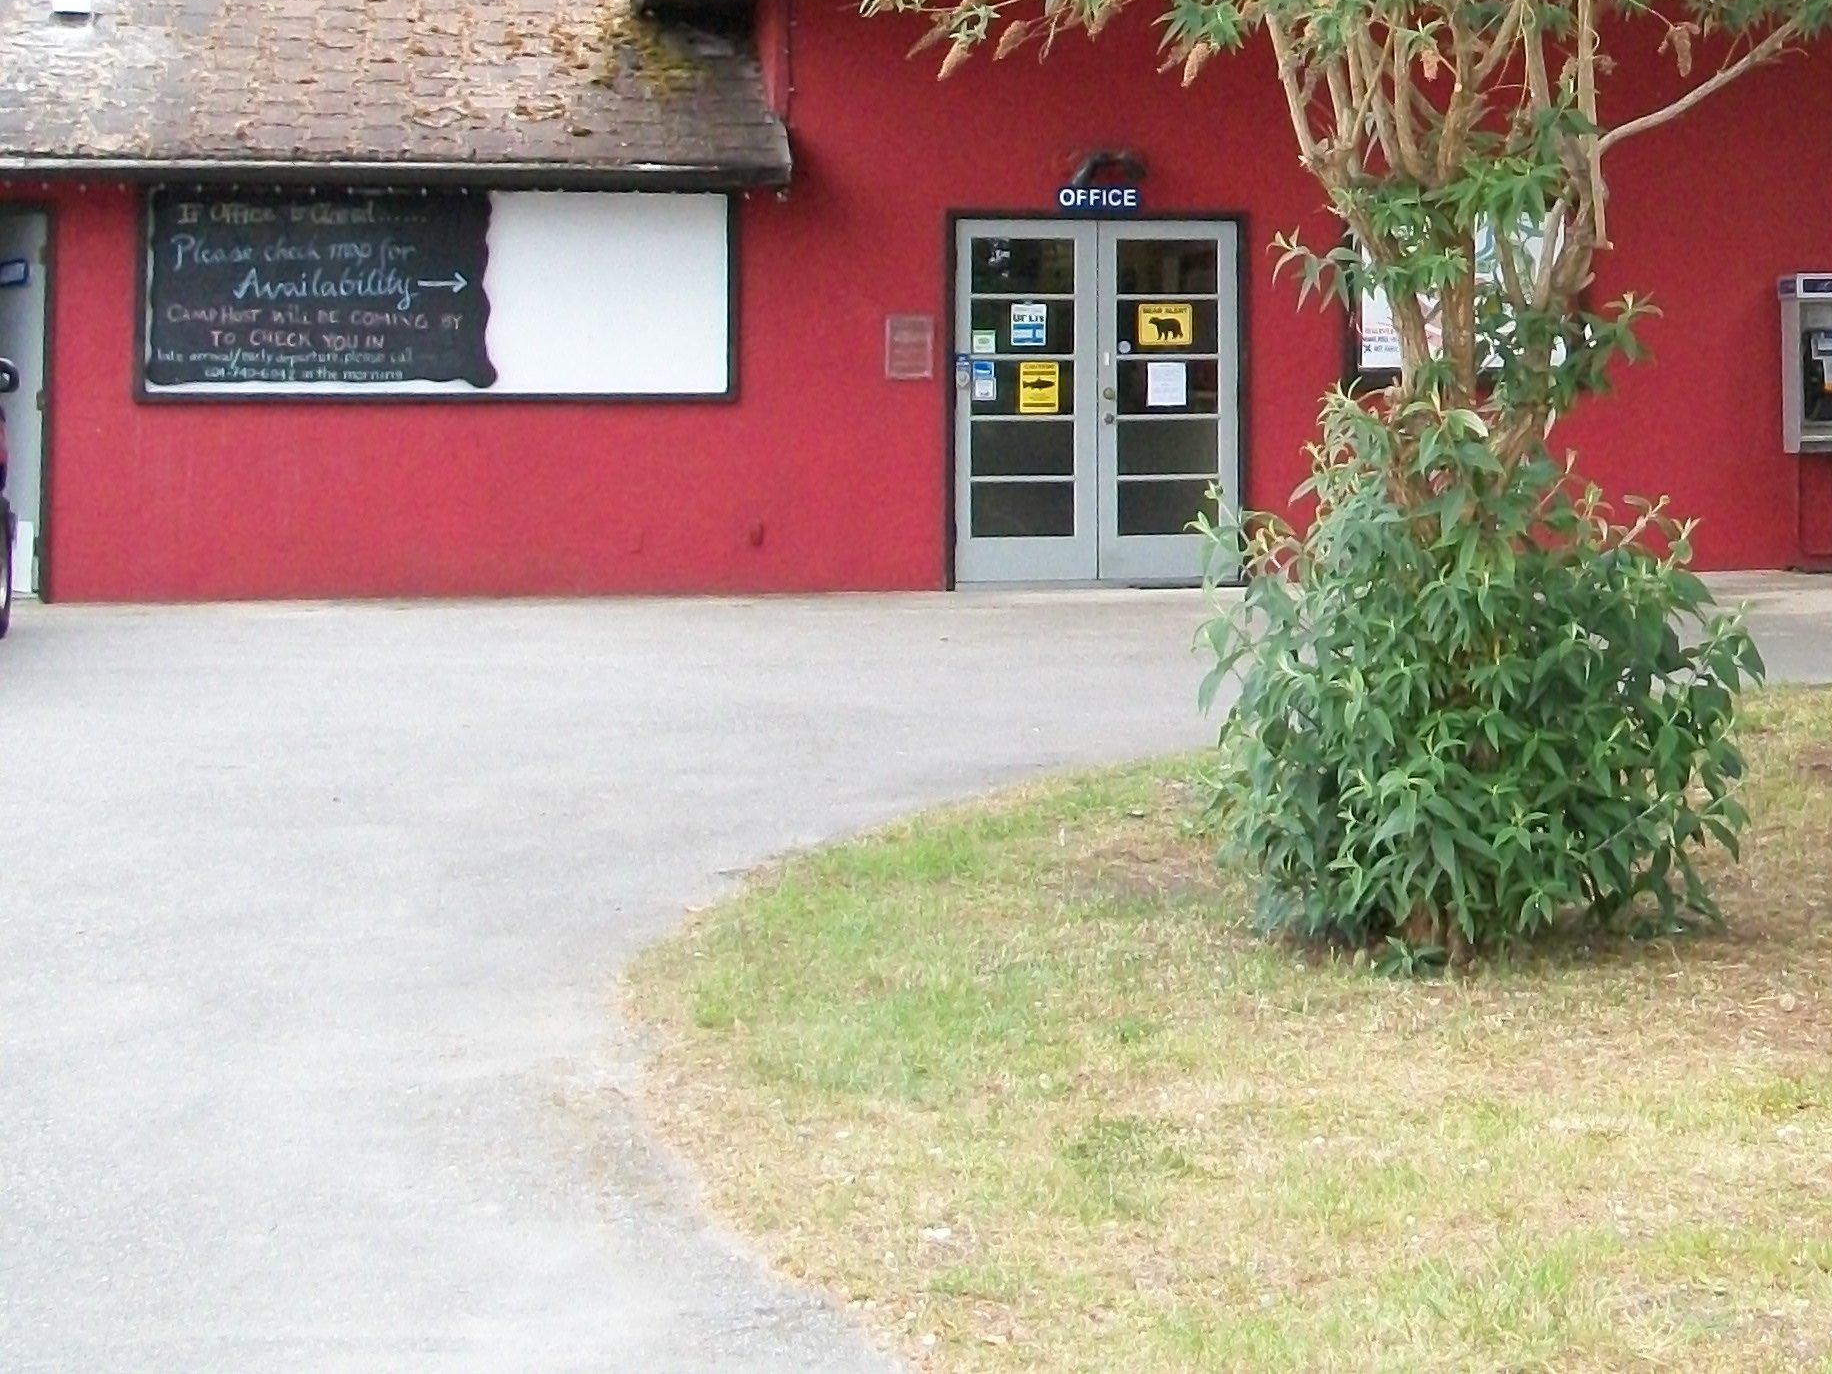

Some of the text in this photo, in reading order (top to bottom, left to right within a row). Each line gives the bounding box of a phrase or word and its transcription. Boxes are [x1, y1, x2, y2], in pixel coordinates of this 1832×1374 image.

[1059, 188, 1137, 206] OFFICE
[170, 233, 253, 273] Please
[379, 235, 416, 276] for
[232, 267, 419, 311] Availability
[351, 310, 429, 329] COMING
[441, 312, 464, 330] BY
[210, 329, 385, 351] TO CHECK YOU IN
